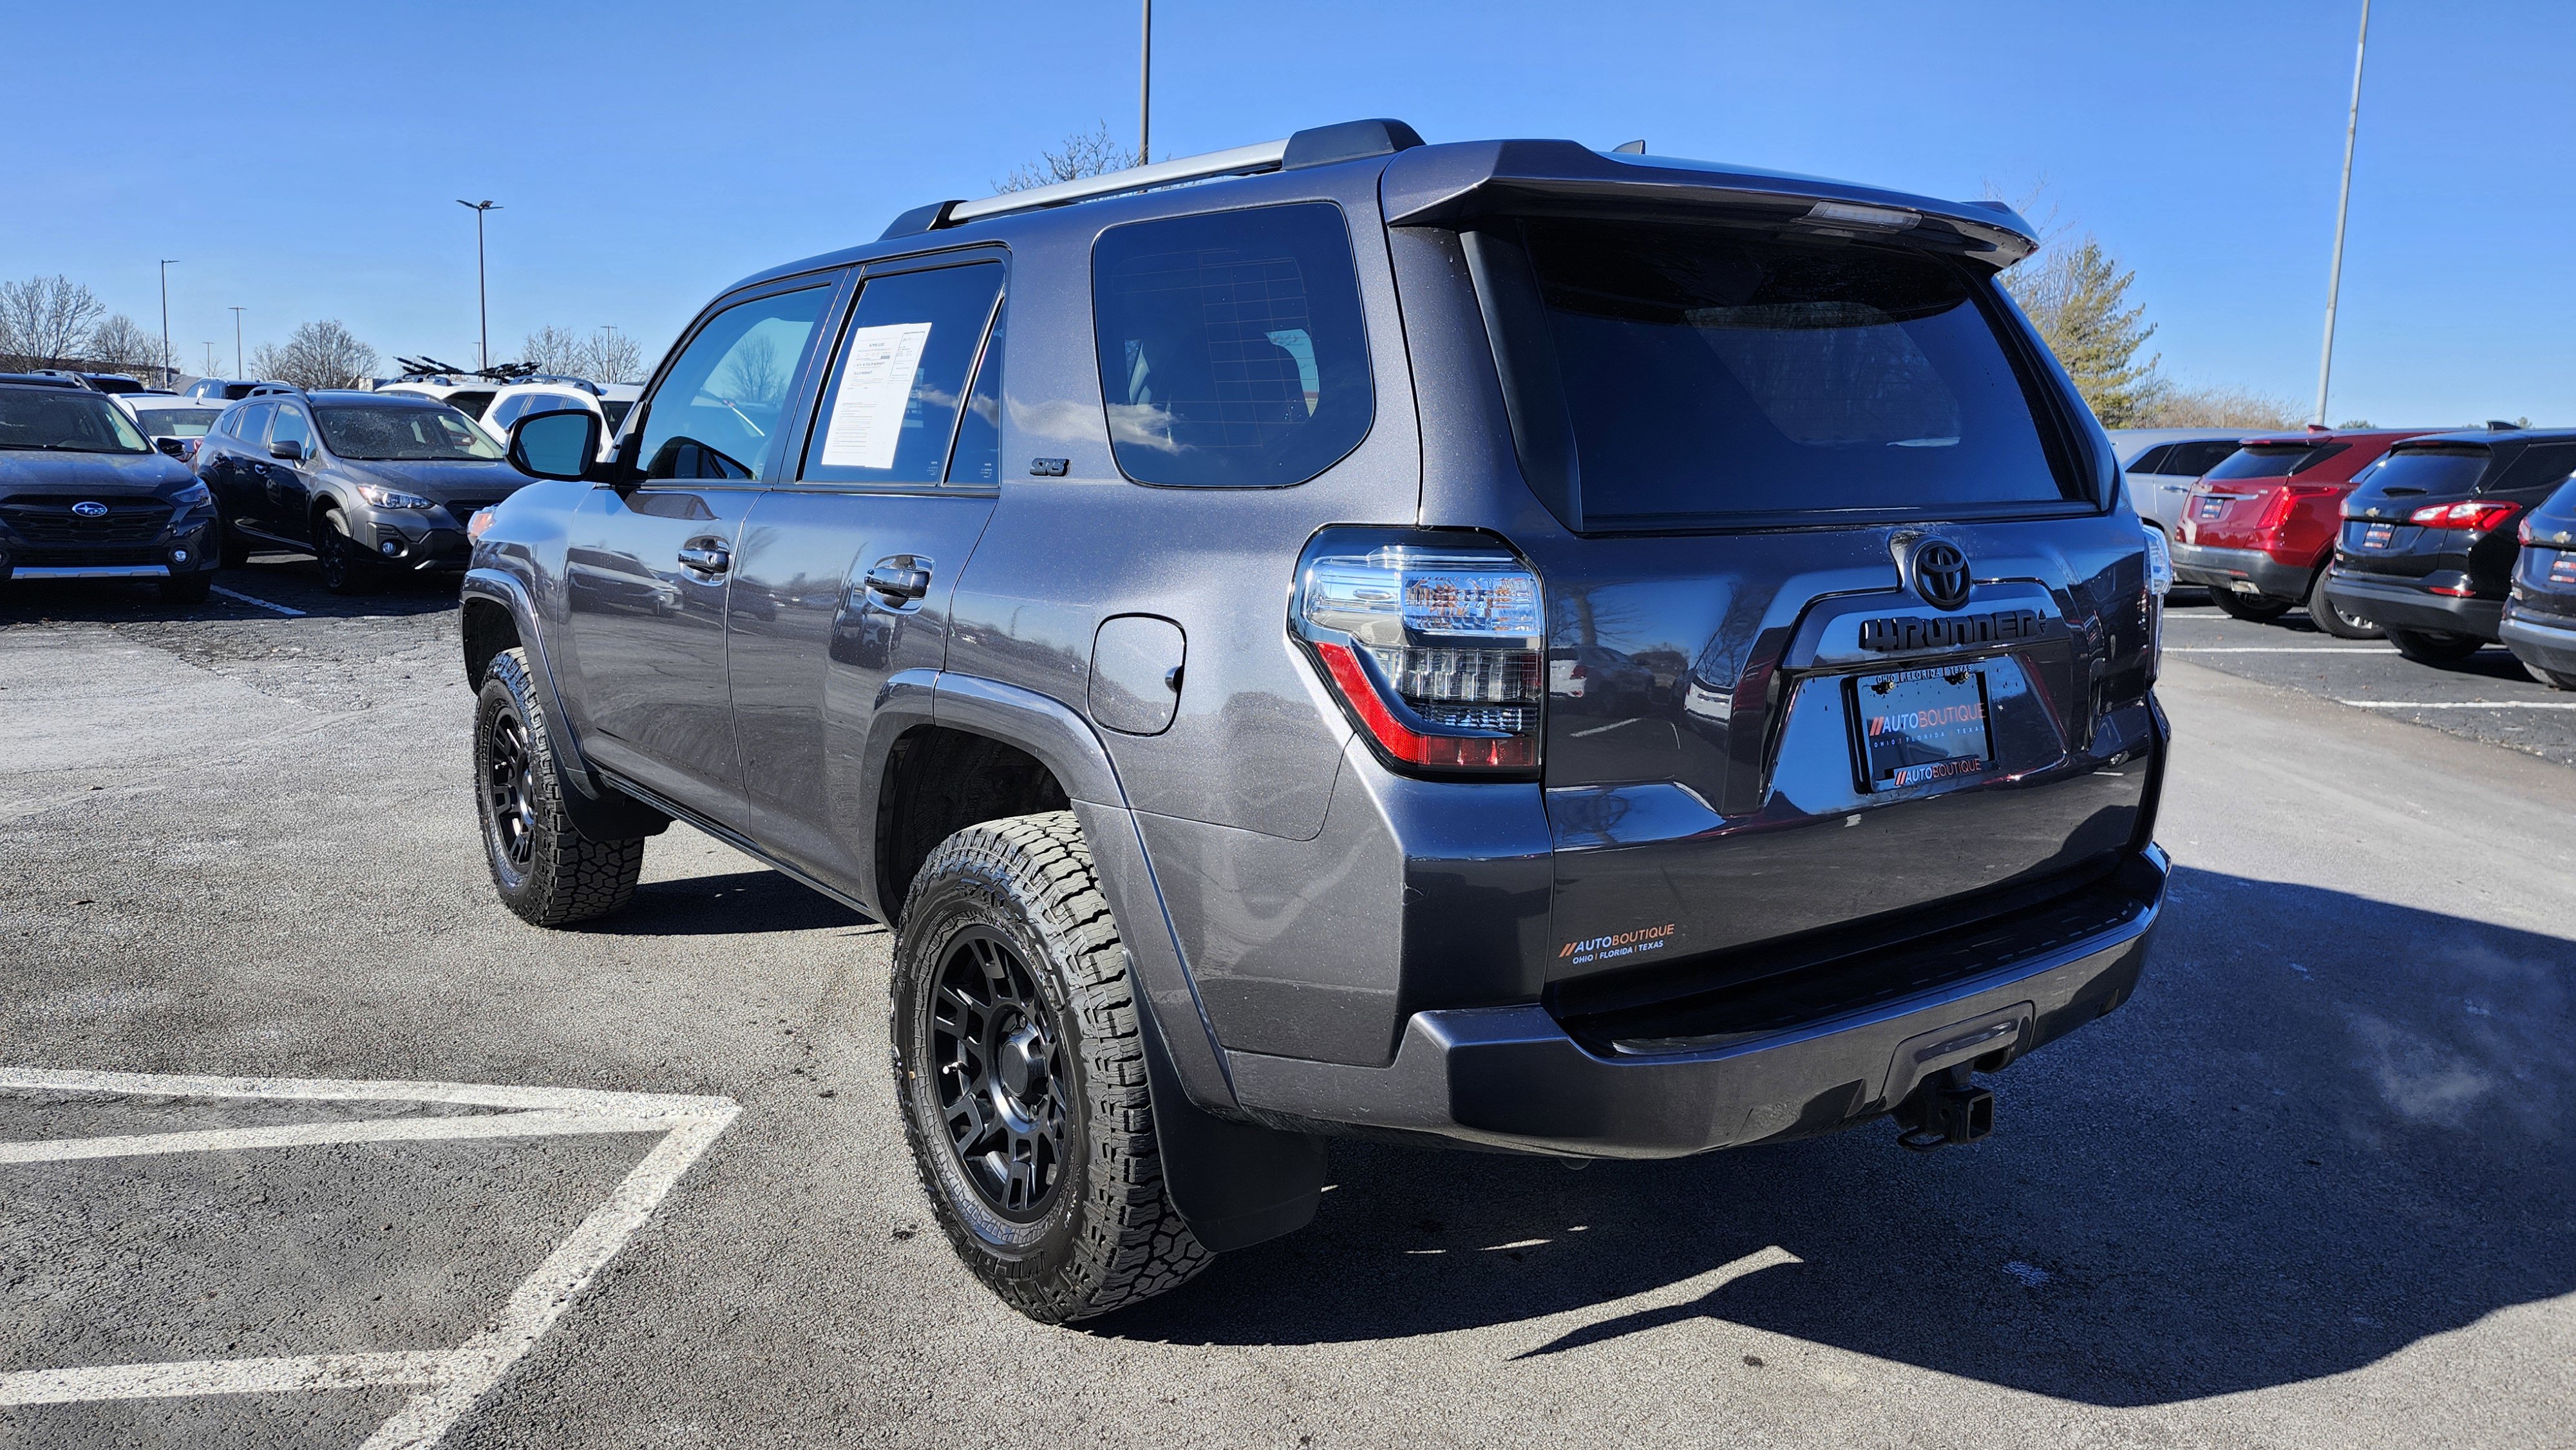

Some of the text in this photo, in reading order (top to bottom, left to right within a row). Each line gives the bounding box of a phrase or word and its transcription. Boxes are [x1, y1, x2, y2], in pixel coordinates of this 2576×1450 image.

[1876, 665, 1973, 684] OHIO FLORIDA TEXAS
[1882, 702, 1986, 734] AUTOBOUTIQUE
[1874, 725, 1985, 748] OHIO FLORIDA TEXAS
[1905, 758, 1982, 784] AUTOBOUTIQUE
[1574, 923, 1675, 954] AUTOBOUTIQUE
[1572, 939, 1664, 965] OHIO FLORIDA TEXAS
